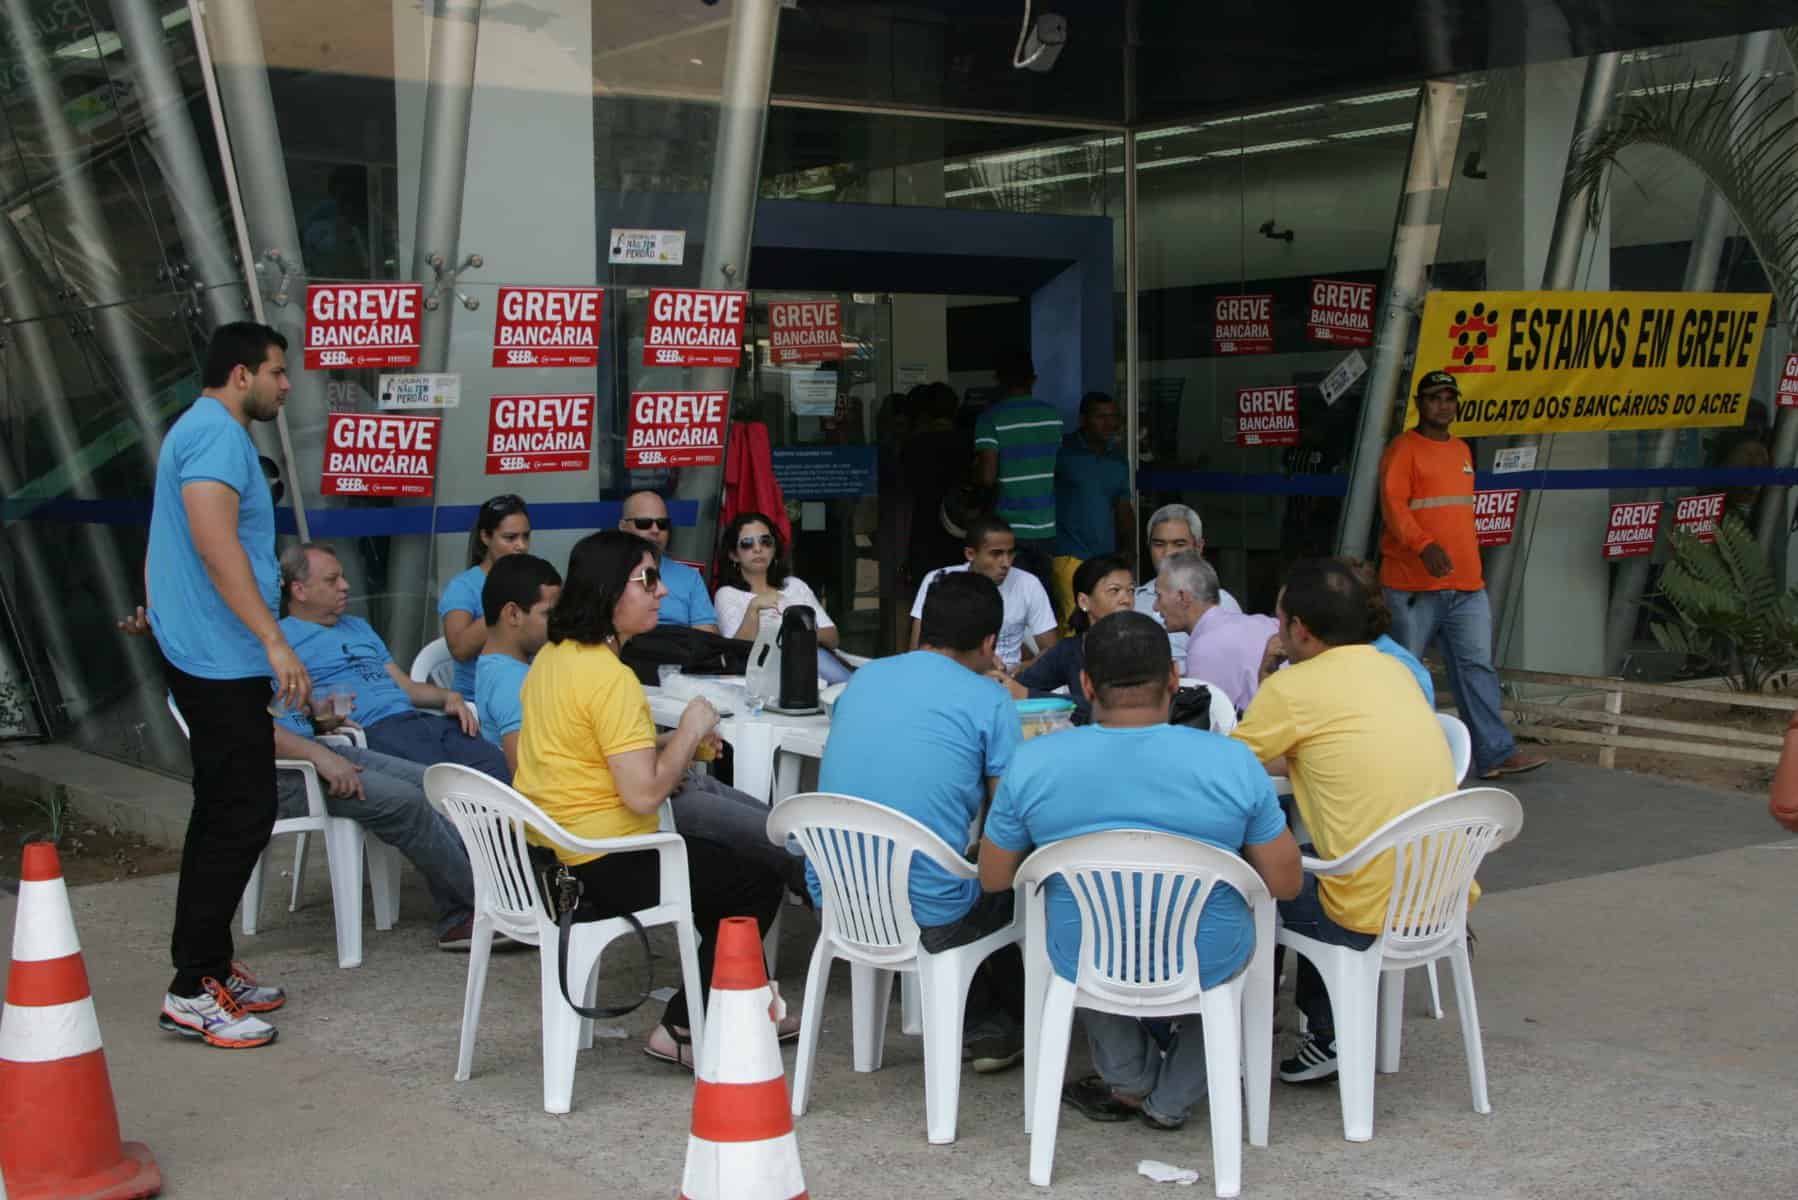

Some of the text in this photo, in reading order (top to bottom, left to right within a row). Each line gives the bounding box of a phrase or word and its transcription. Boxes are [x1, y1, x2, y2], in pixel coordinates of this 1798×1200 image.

[312, 289, 416, 320] GREVE
[503, 291, 598, 322] GREVE
[654, 292, 742, 324] GREVE
[1313, 284, 1372, 310] GREVE
[773, 304, 838, 328] GREVE
[1216, 298, 1271, 321] GREVE
[1311, 309, 1370, 328] BANCÁRIA
[311, 320, 414, 346] BANCÁRIA
[500, 321, 594, 346] BANCÁRIA
[650, 323, 736, 346] BANCÁRIA
[773, 327, 838, 346] BANCÁRIA
[1215, 320, 1270, 338] BANCÁRIA
[1507, 307, 1758, 372] ESTAMOS EM GREVE
[496, 398, 590, 429] GREVE
[636, 396, 724, 424] GREVE
[1239, 390, 1295, 414] GREVE
[1456, 389, 1742, 423] NDICATO DOS BANCÁRIOS DO ACRE
[1240, 412, 1295, 431] BANCÁRIA
[334, 418, 435, 450] GREVE
[492, 427, 585, 452] BANCÁRIA
[632, 424, 718, 447] BANCÁRIA
[329, 450, 428, 474] BANCÁRIA
[1612, 504, 1660, 527] GREVE
[1677, 497, 1724, 520] GREVE
[1475, 514, 1512, 531] NCÁRIA
[1608, 524, 1654, 543] BANCÁRIA
